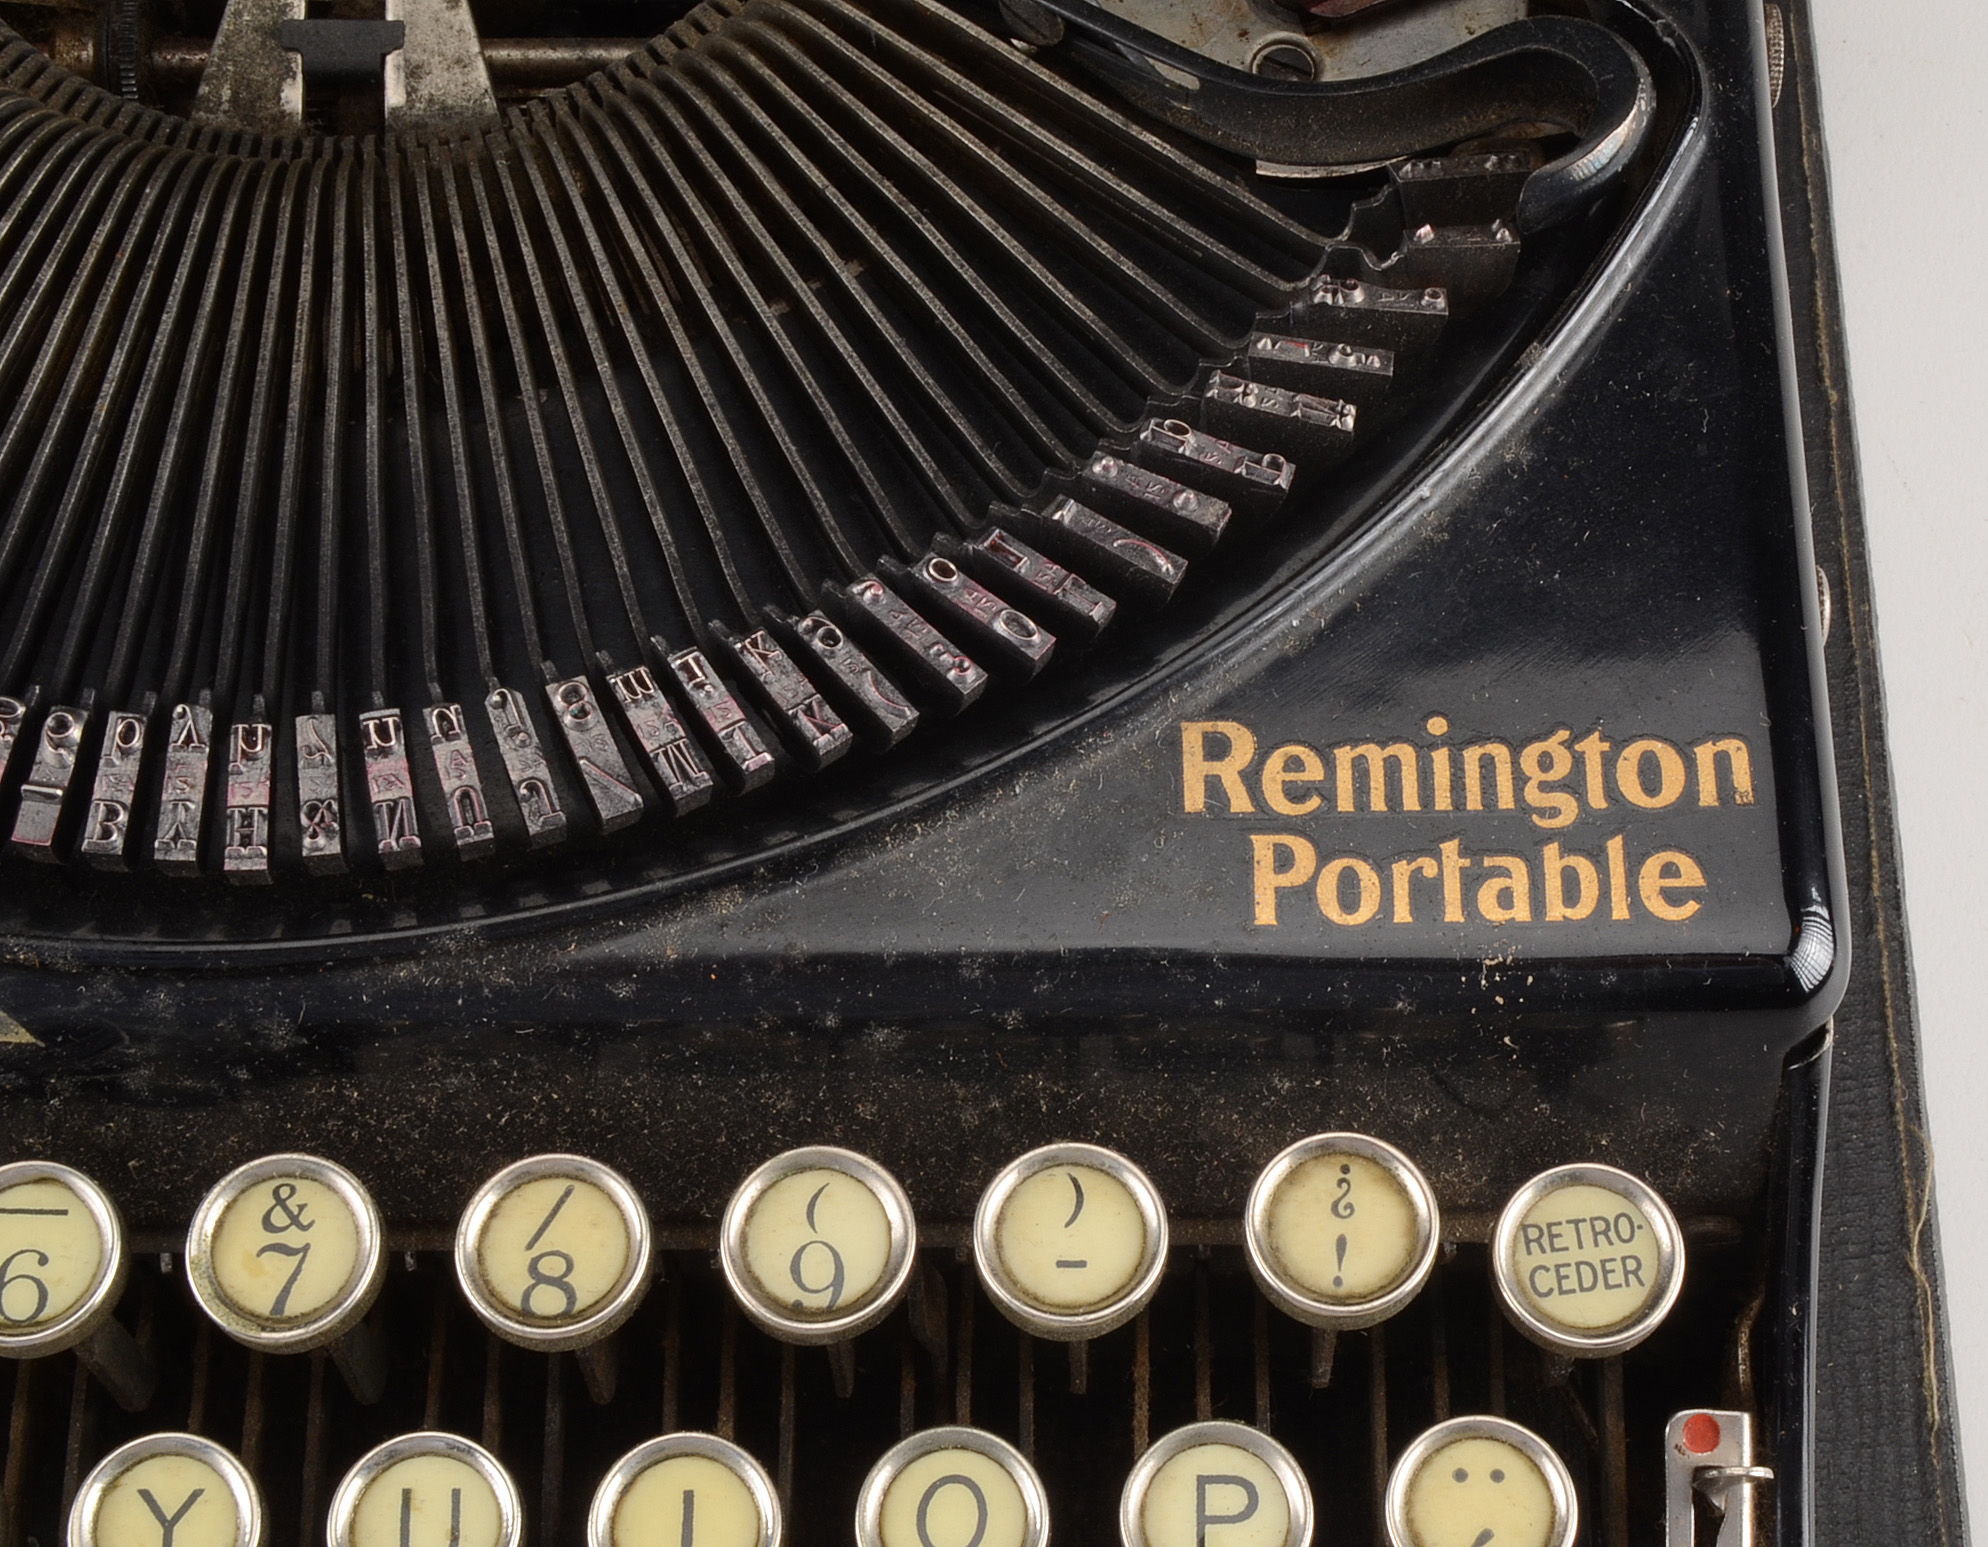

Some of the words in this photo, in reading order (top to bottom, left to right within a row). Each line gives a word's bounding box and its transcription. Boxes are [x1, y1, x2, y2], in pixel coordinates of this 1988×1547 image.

[1180, 716, 1755, 829] Remington
[1249, 833, 1708, 926] Portable
[261, 1183, 316, 1234] &
[1520, 1211, 1645, 1256] RETRO-
[0, 1248, 50, 1323] 6
[255, 1242, 312, 1317] 7
[520, 1250, 578, 1318] 8
[789, 1240, 846, 1313] 9
[1528, 1253, 1646, 1299] CEDER
[1196, 1474, 1260, 1547] P
